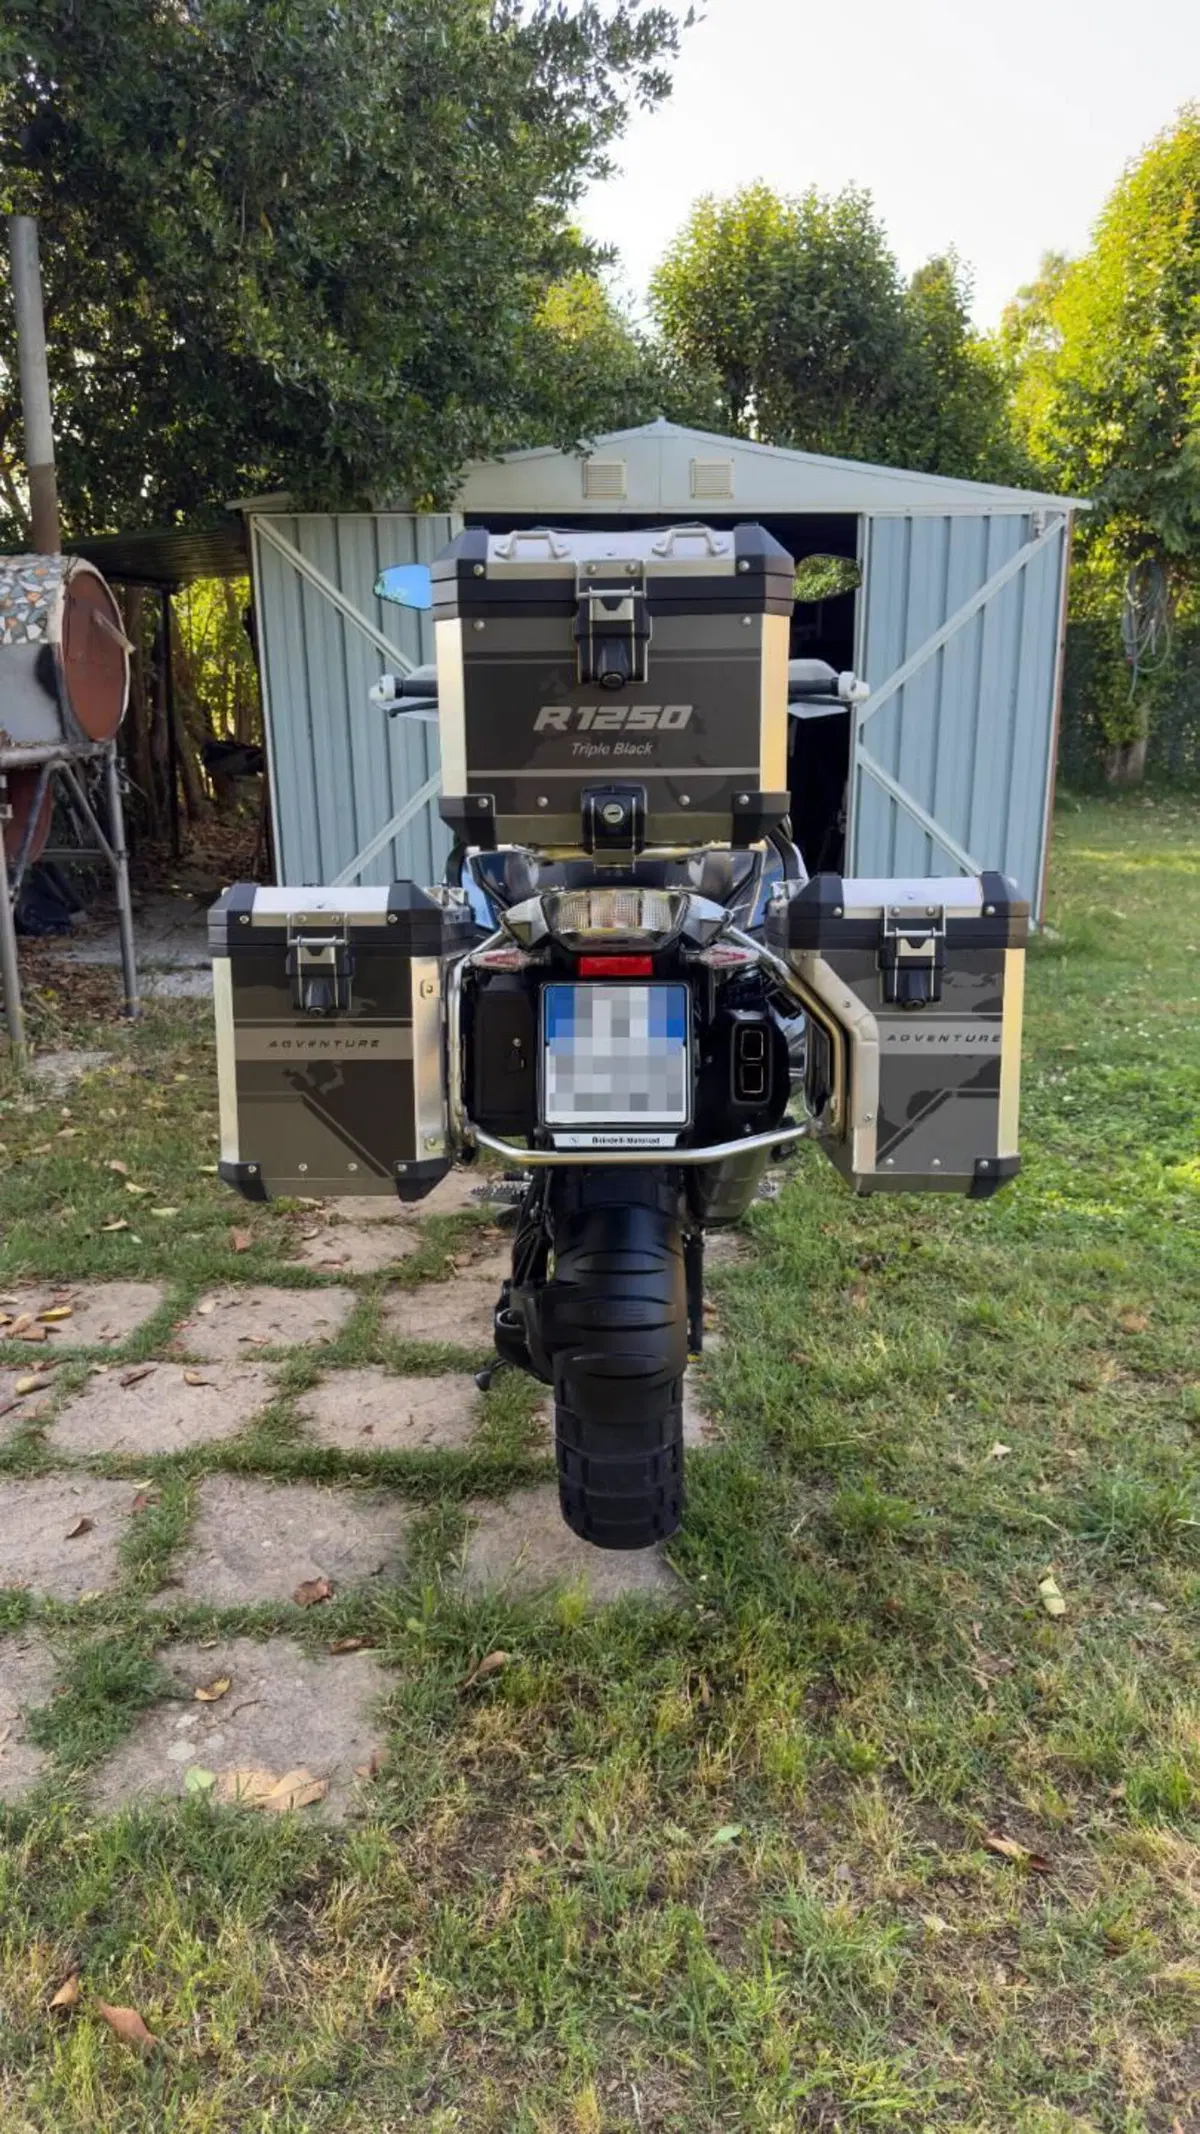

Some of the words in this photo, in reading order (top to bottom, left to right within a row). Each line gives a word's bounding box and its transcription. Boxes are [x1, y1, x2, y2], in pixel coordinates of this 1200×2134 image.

[572, 742, 610, 757] Triple
[613, 742, 654, 755] Black
[886, 1034, 1001, 1042] ADVENTURE
[268, 1039, 380, 1048] ADVENTURE
